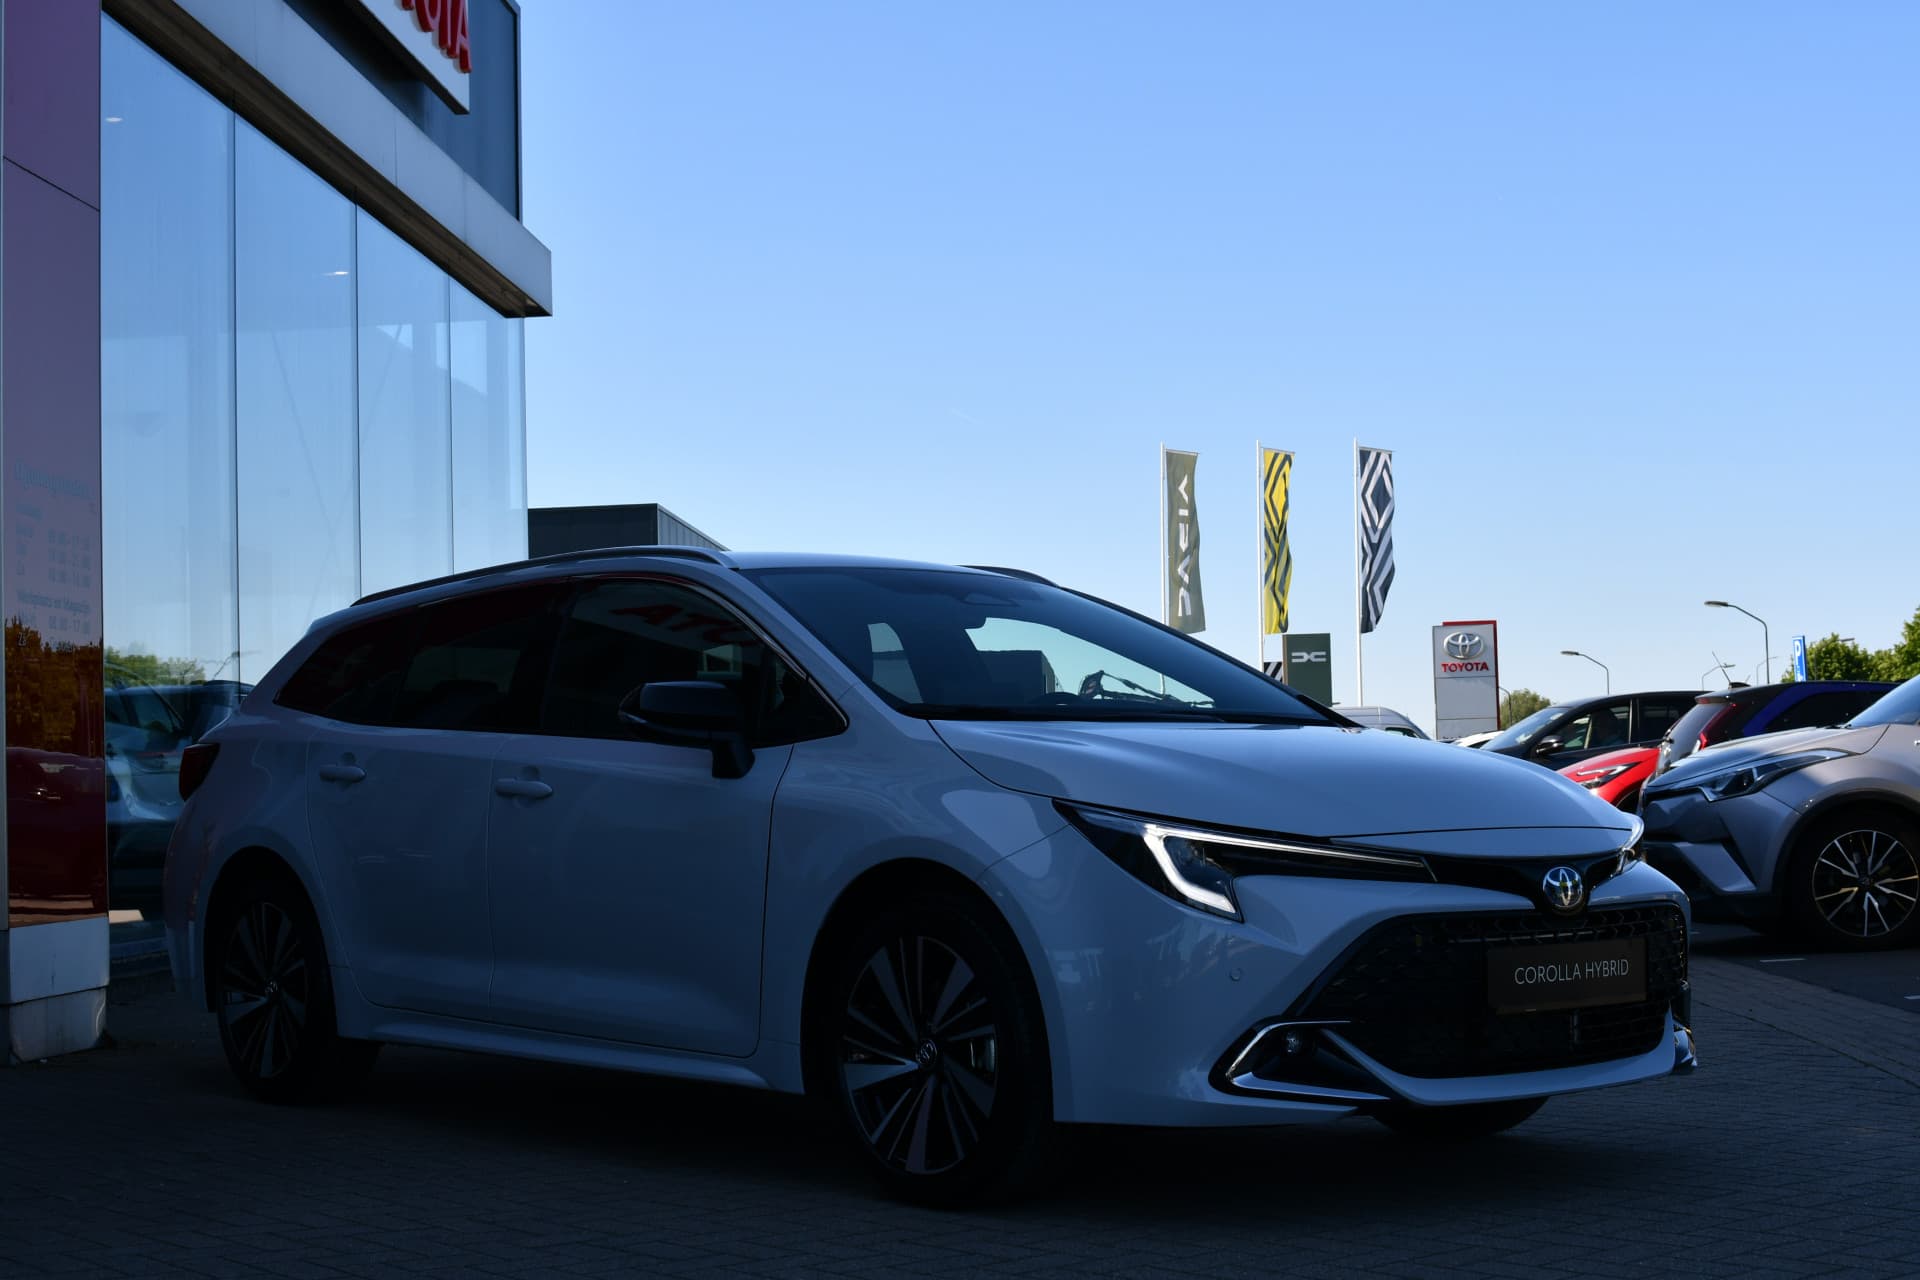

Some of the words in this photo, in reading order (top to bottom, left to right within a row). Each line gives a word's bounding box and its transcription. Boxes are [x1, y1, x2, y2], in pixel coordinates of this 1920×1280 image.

[1441, 661, 1489, 672] TOYOTA
[1514, 963, 1582, 985] COROLLA
[1585, 959, 1629, 979] HYBRID
